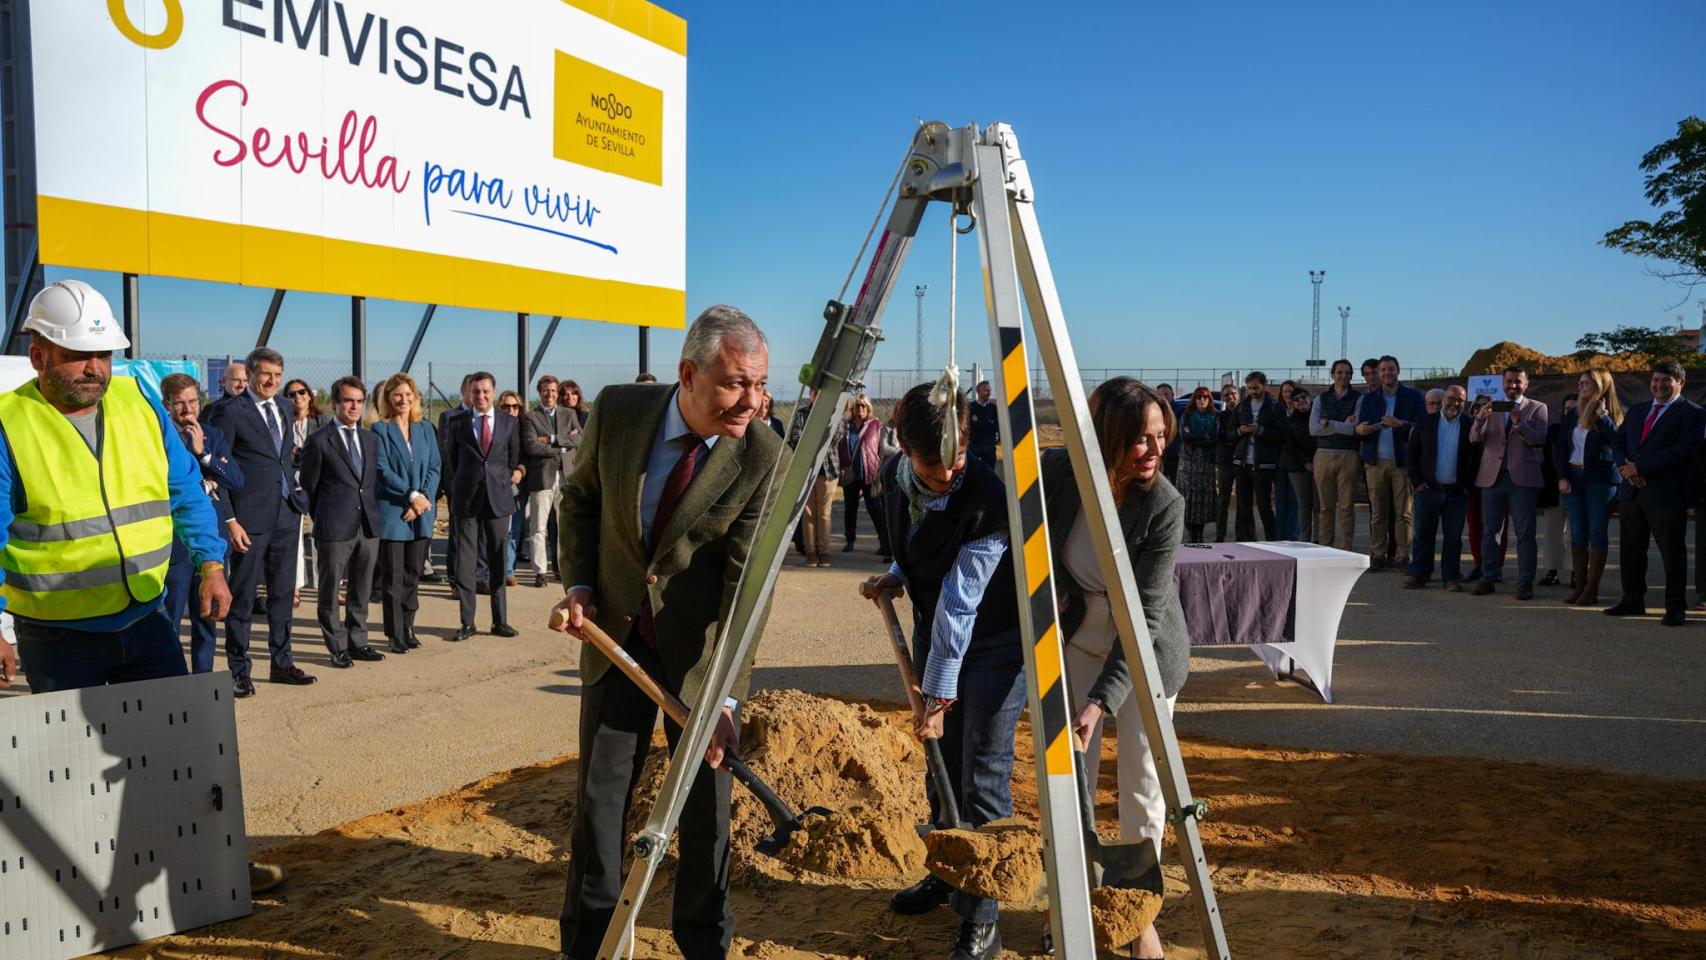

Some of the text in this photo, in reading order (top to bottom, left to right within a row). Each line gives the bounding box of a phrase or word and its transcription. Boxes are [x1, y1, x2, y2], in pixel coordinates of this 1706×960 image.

[576, 112, 645, 146] AYUNTAMIENTO
[586, 134, 635, 158] DE SEVILLA
[195, 79, 601, 227] Sevilla para vivir
